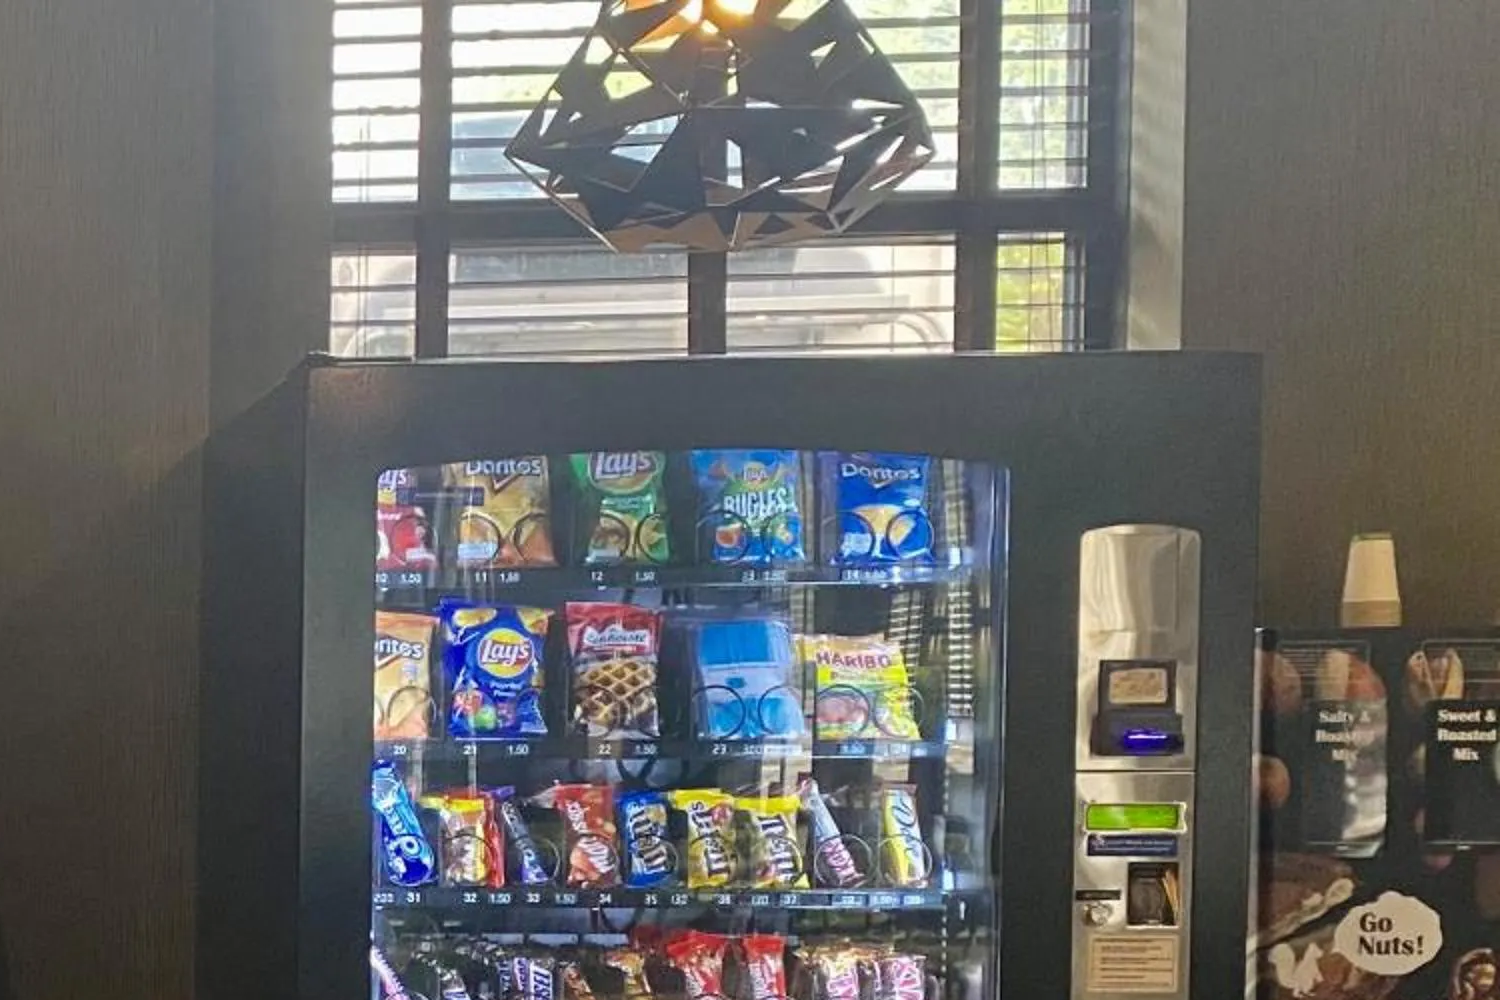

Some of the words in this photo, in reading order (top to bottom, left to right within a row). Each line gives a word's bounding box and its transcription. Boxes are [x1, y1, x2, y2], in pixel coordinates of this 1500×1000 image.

[466, 457, 541, 476] Doritos
[723, 488, 789, 518] BUGLES
[375, 639, 422, 659] ritos
[479, 640, 531, 668] Lay's
[814, 651, 893, 671] HARIBO
[1437, 709, 1482, 723] Sweet
[1437, 728, 1497, 742] Roasted
[393, 744, 407, 755] 20
[1452, 747, 1480, 761] Mix
[1359, 911, 1393, 932] Go
[1359, 935, 1424, 955] Nuts!
